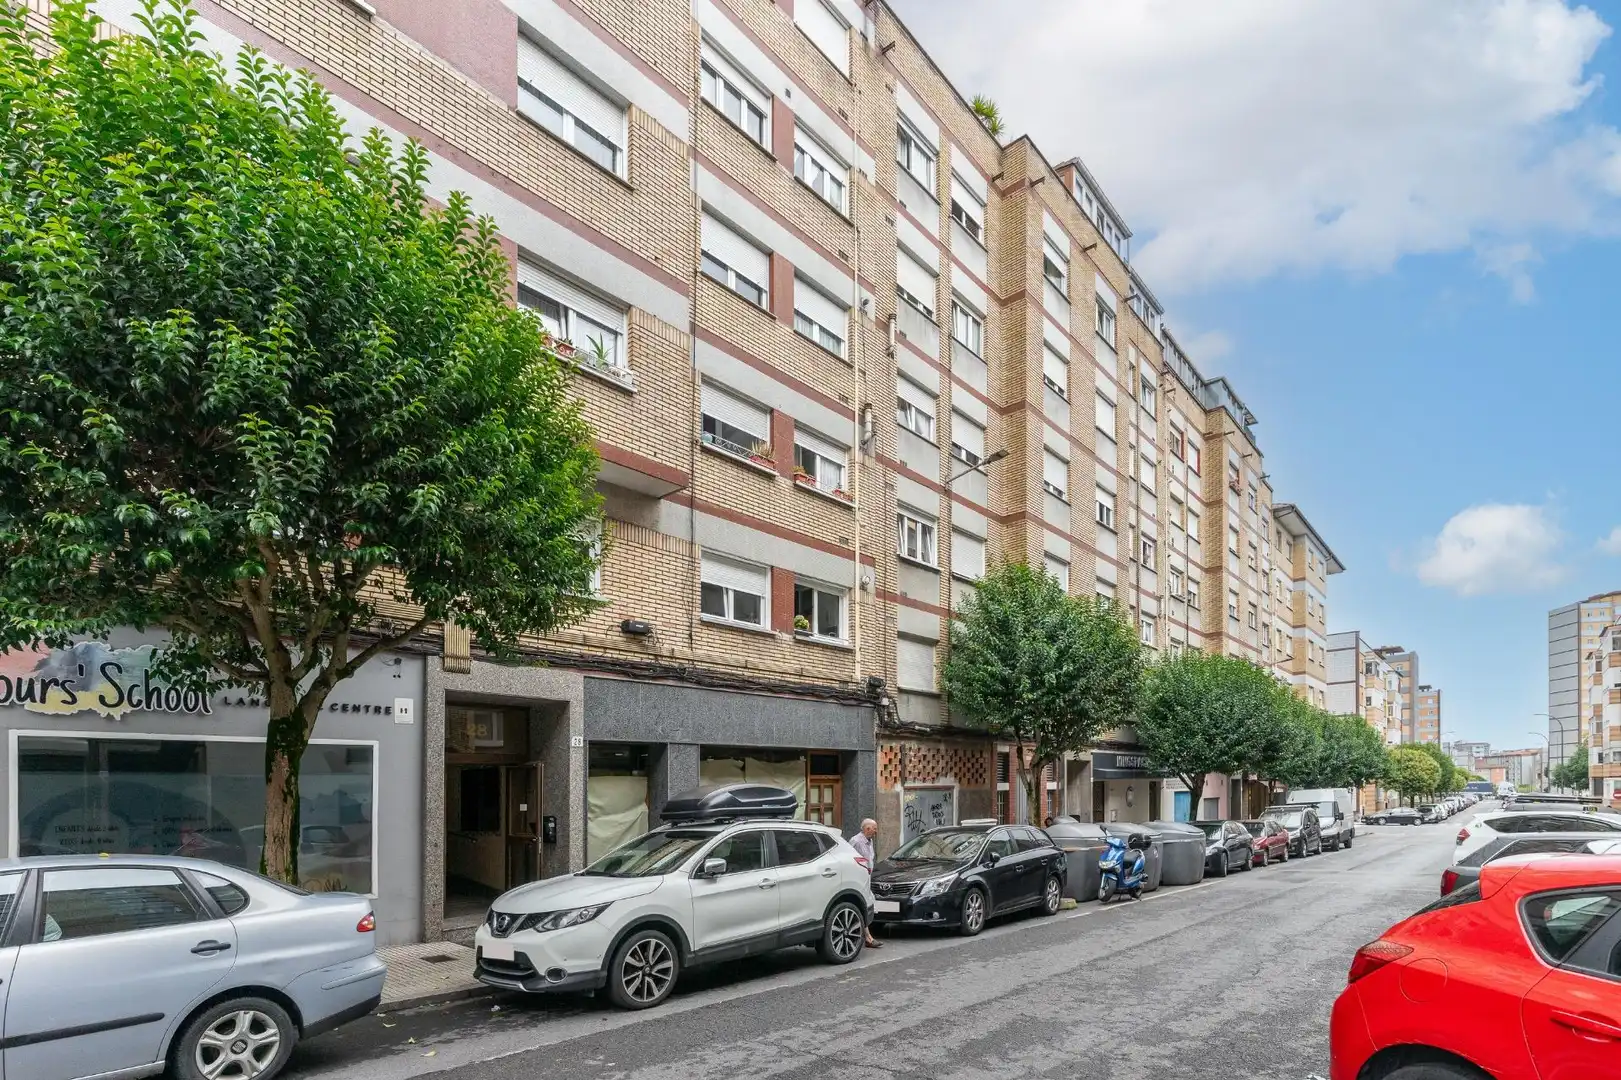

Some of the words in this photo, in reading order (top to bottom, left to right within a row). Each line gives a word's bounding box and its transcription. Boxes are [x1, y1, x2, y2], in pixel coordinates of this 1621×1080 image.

[99, 661, 211, 713] School
[329, 702, 393, 716] CENTRE
[465, 723, 488, 736] 28
[573, 738, 583, 746] 28
